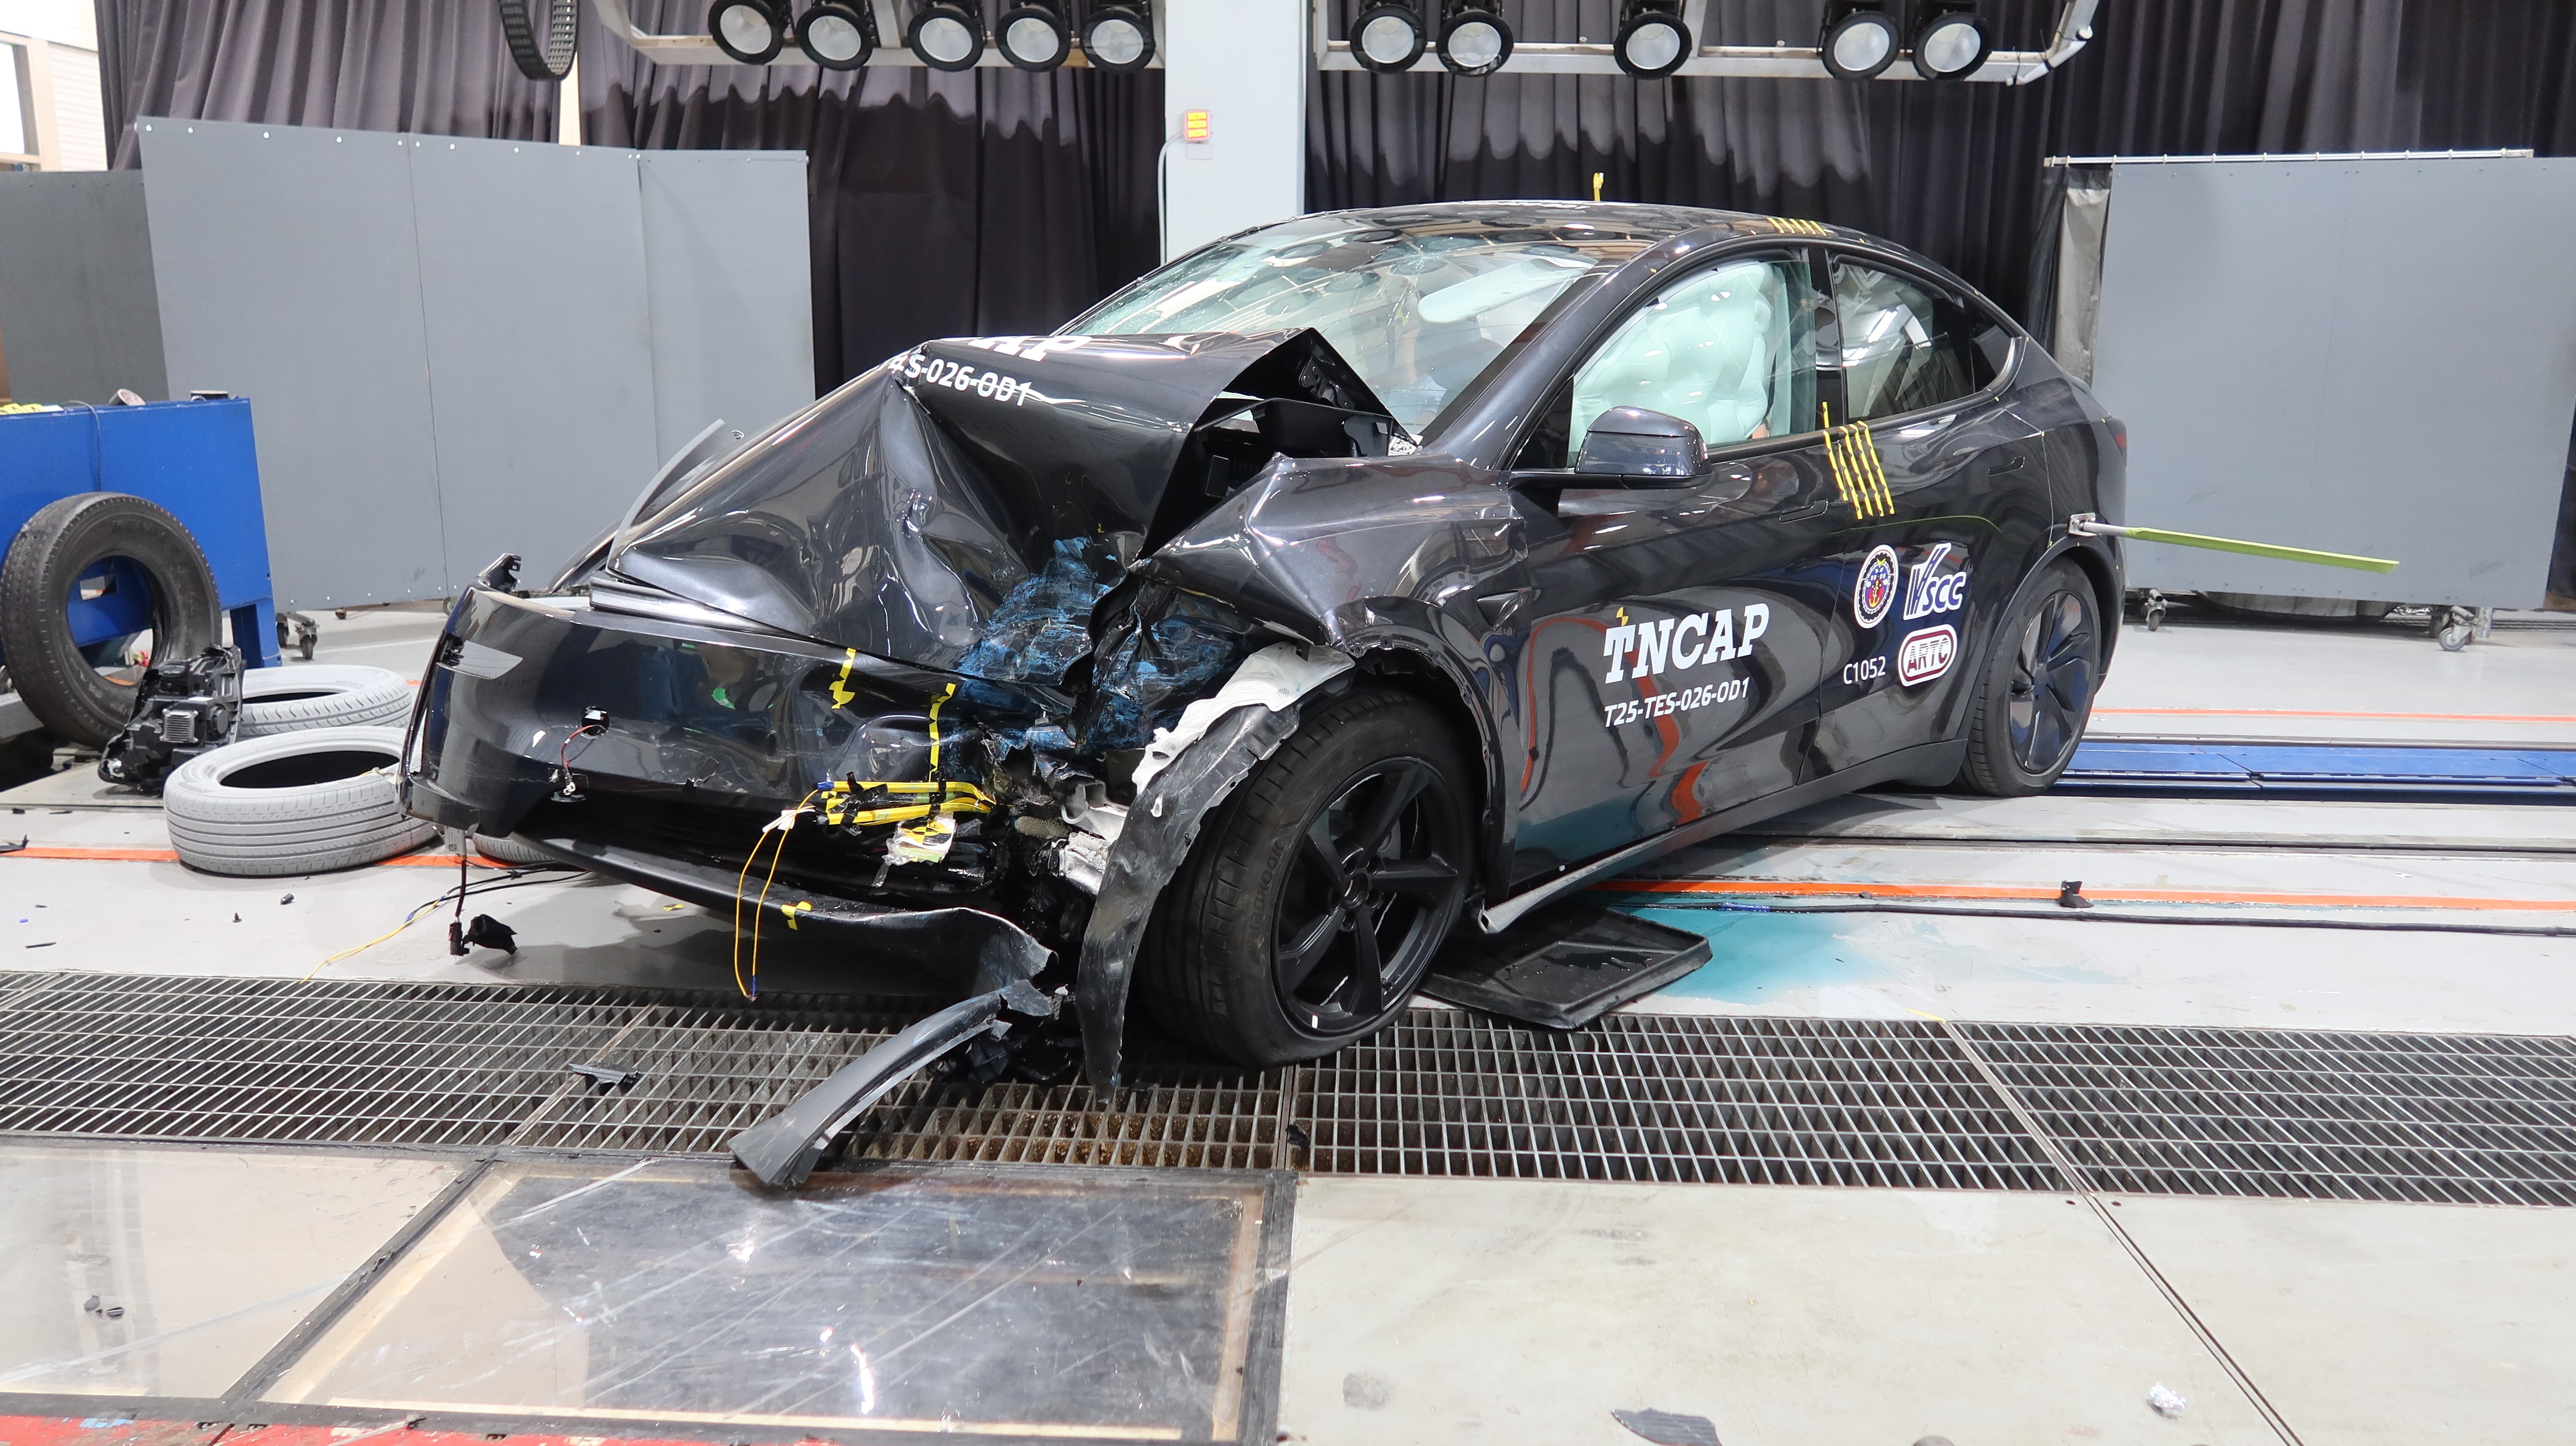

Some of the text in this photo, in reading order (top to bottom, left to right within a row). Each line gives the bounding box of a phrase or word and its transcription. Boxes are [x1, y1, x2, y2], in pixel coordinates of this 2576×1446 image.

[1906, 547, 1964, 616] VSCC
[1602, 603, 1769, 684] TNCAP
[1907, 637, 1949, 674] ARTC
[1843, 656, 1886, 685] C1052
[1604, 676, 1750, 728] T25-TES-026-OD1
